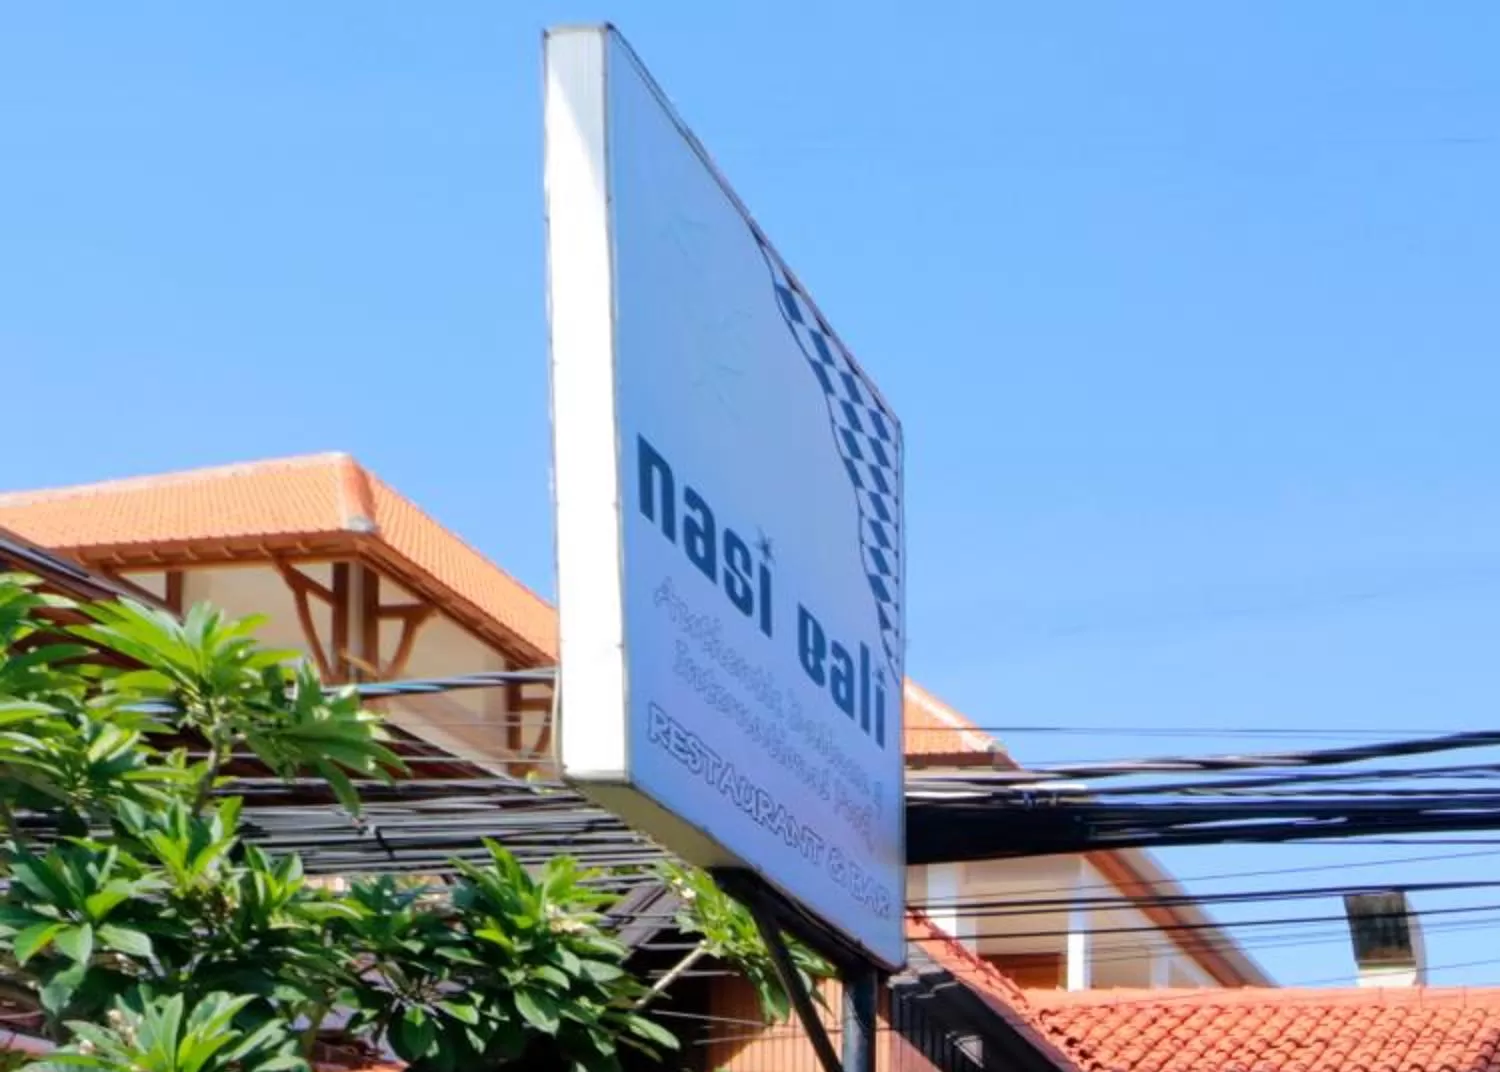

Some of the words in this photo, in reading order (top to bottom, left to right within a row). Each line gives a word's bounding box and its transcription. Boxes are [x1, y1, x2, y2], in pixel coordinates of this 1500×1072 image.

[637, 432, 775, 640] nasi
[649, 701, 825, 866] RESTAURANT
[849, 857, 892, 921] BAR
